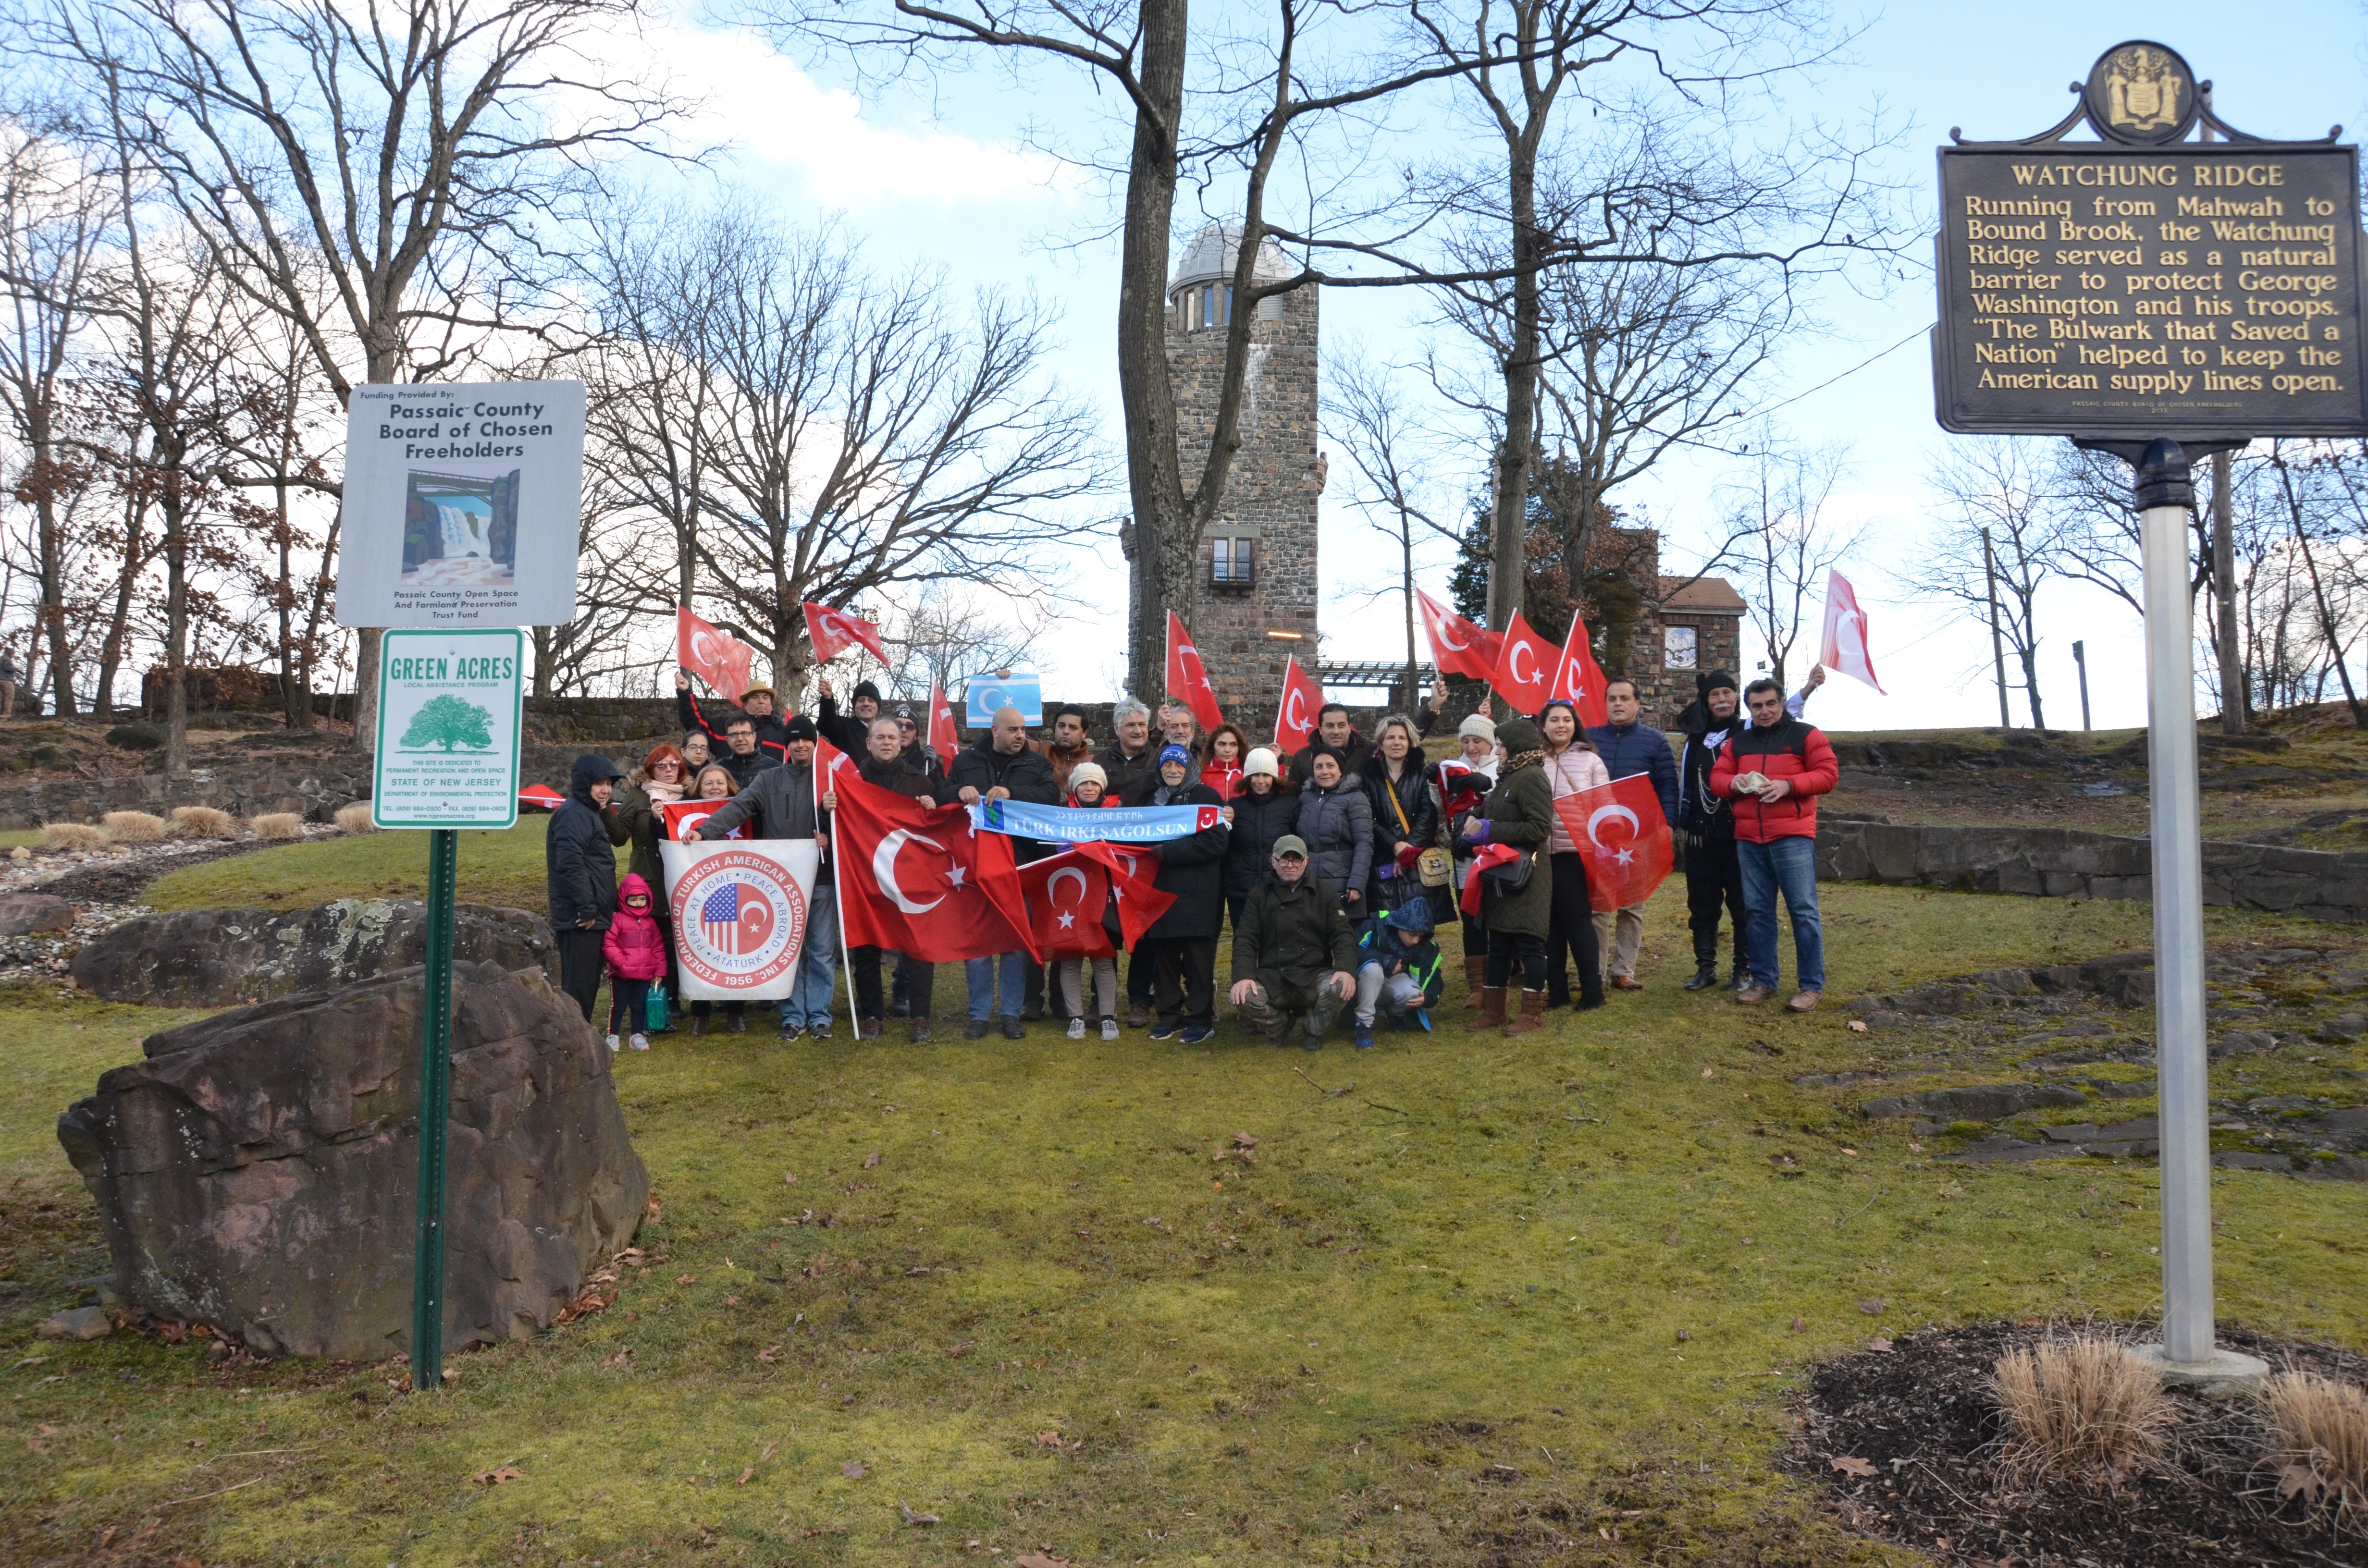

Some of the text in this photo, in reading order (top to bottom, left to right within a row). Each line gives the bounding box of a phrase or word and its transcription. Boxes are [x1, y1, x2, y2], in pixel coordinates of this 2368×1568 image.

[2011, 165, 2284, 187] WATCHUNG RIDGE
[1965, 196, 2334, 220] Running from Mahwah to
[1967, 220, 2336, 246] Bound Brook, the Watchung
[1969, 245, 2337, 269] Ridge served as a natural
[1970, 270, 2337, 297] barrier to protect George
[1971, 294, 2340, 320] Washington and his troops.
[2049, 320, 2153, 341] Bulwark
[2165, 321, 2217, 341] that
[2231, 321, 2310, 341] Saved
[2324, 325, 2340, 341] a
[2079, 344, 2168, 369] helped
[2181, 347, 2207, 365] to
[2220, 346, 2285, 370] keep
[2297, 346, 2341, 366] the
[1978, 368, 2343, 395] American supply lines open.
[360, 392, 394, 401] Funding
[441, 391, 454, 400] By:
[390, 402, 544, 419] Passaic County
[380, 422, 553, 439] Board of Chosen
[406, 441, 523, 459] Freeholders
[430, 591, 461, 600] County
[465, 590, 488, 599] Open
[493, 590, 518, 598] Space
[391, 657, 513, 680] GREEN ACRES
[1011, 818, 1187, 838] TÜRK IRKI SAĞOLSUN
[676, 859, 721, 898] TURKISH
[724, 856, 786, 883] AMERICAN
[673, 901, 681, 917] OF
[687, 872, 733, 951] PEACE AT HOME
[744, 872, 787, 948] PEACE ABROAD
[778, 883, 803, 966] ASSOCIATIONS
[674, 920, 718, 981] FEDERATION
[713, 955, 763, 968] ATATÜRK
[725, 975, 753, 985] 1956
